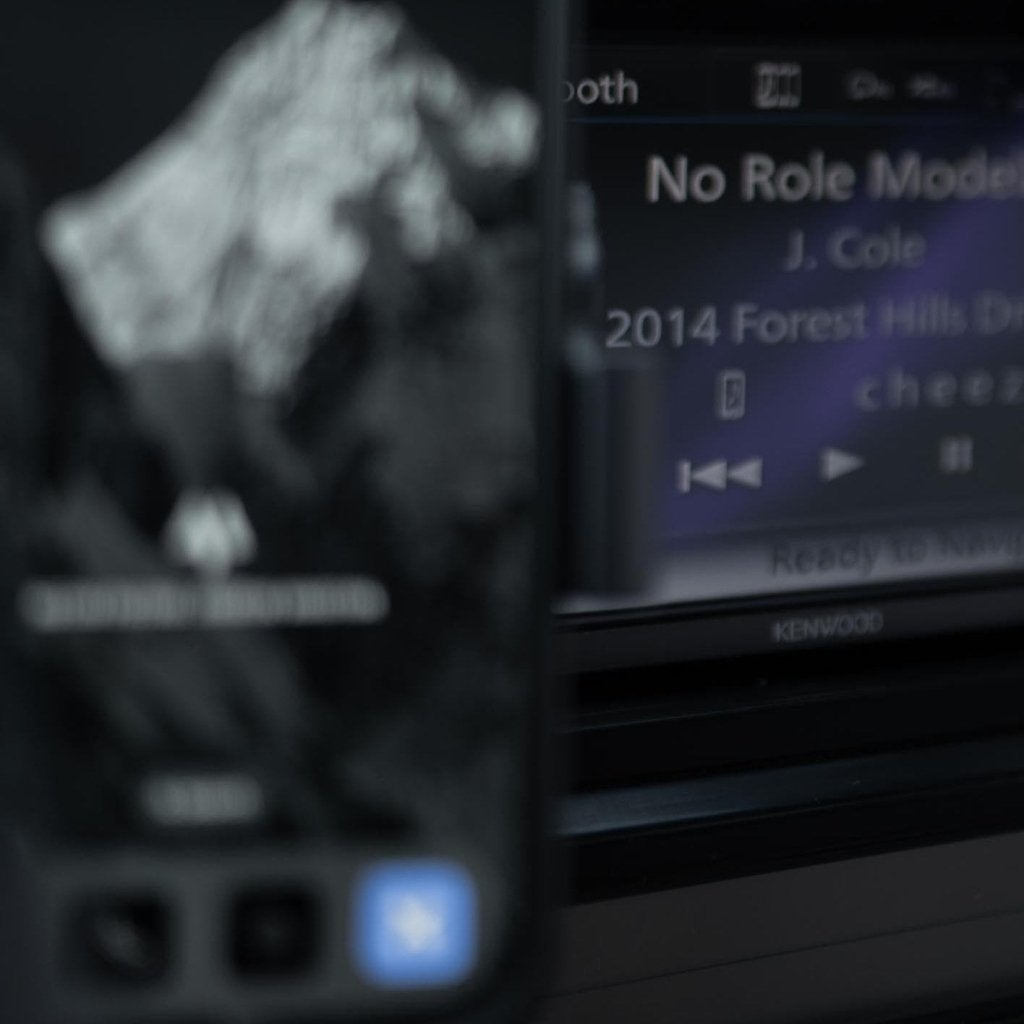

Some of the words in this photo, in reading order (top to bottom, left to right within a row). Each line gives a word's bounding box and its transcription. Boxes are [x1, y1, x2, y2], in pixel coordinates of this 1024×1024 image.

[645, 153, 727, 204] No
[739, 148, 857, 203] Role
[783, 229, 818, 272] J.
[826, 225, 927, 270] Cole
[604, 304, 721, 350] 2014
[729, 300, 868, 346] Forest
[877, 289, 968, 339] Hills
[771, 537, 875, 578] Ready
[773, 611, 884, 642] KENWOOD
